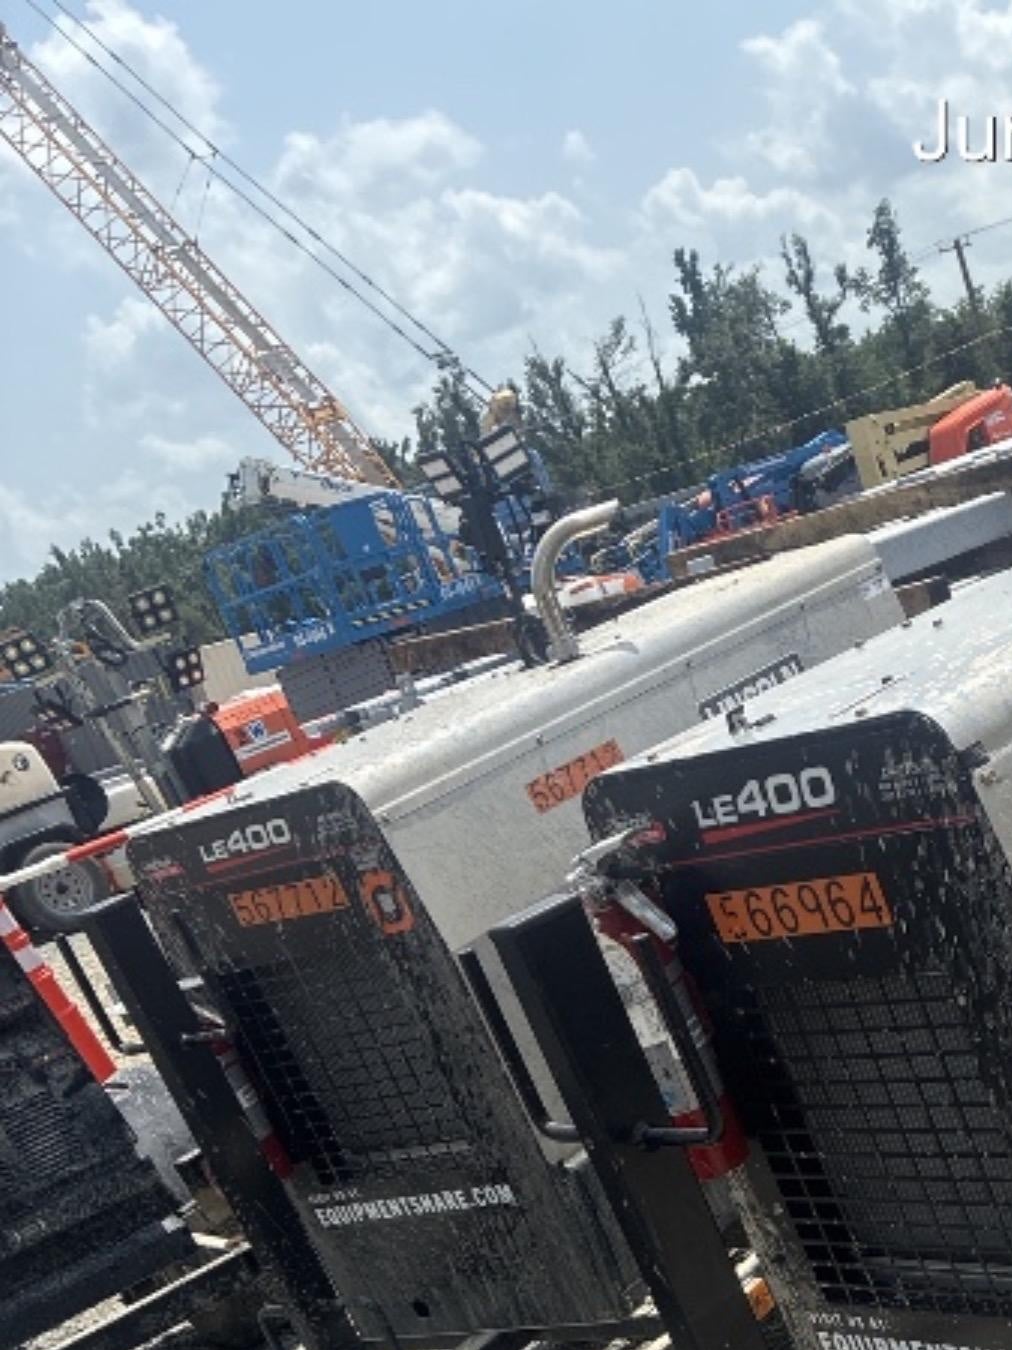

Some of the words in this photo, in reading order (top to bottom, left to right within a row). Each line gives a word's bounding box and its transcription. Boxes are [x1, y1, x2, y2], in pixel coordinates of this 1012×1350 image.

[692, 766, 836, 829] LE400
[200, 817, 291, 863] LE400
[718, 874, 888, 941] 566964
